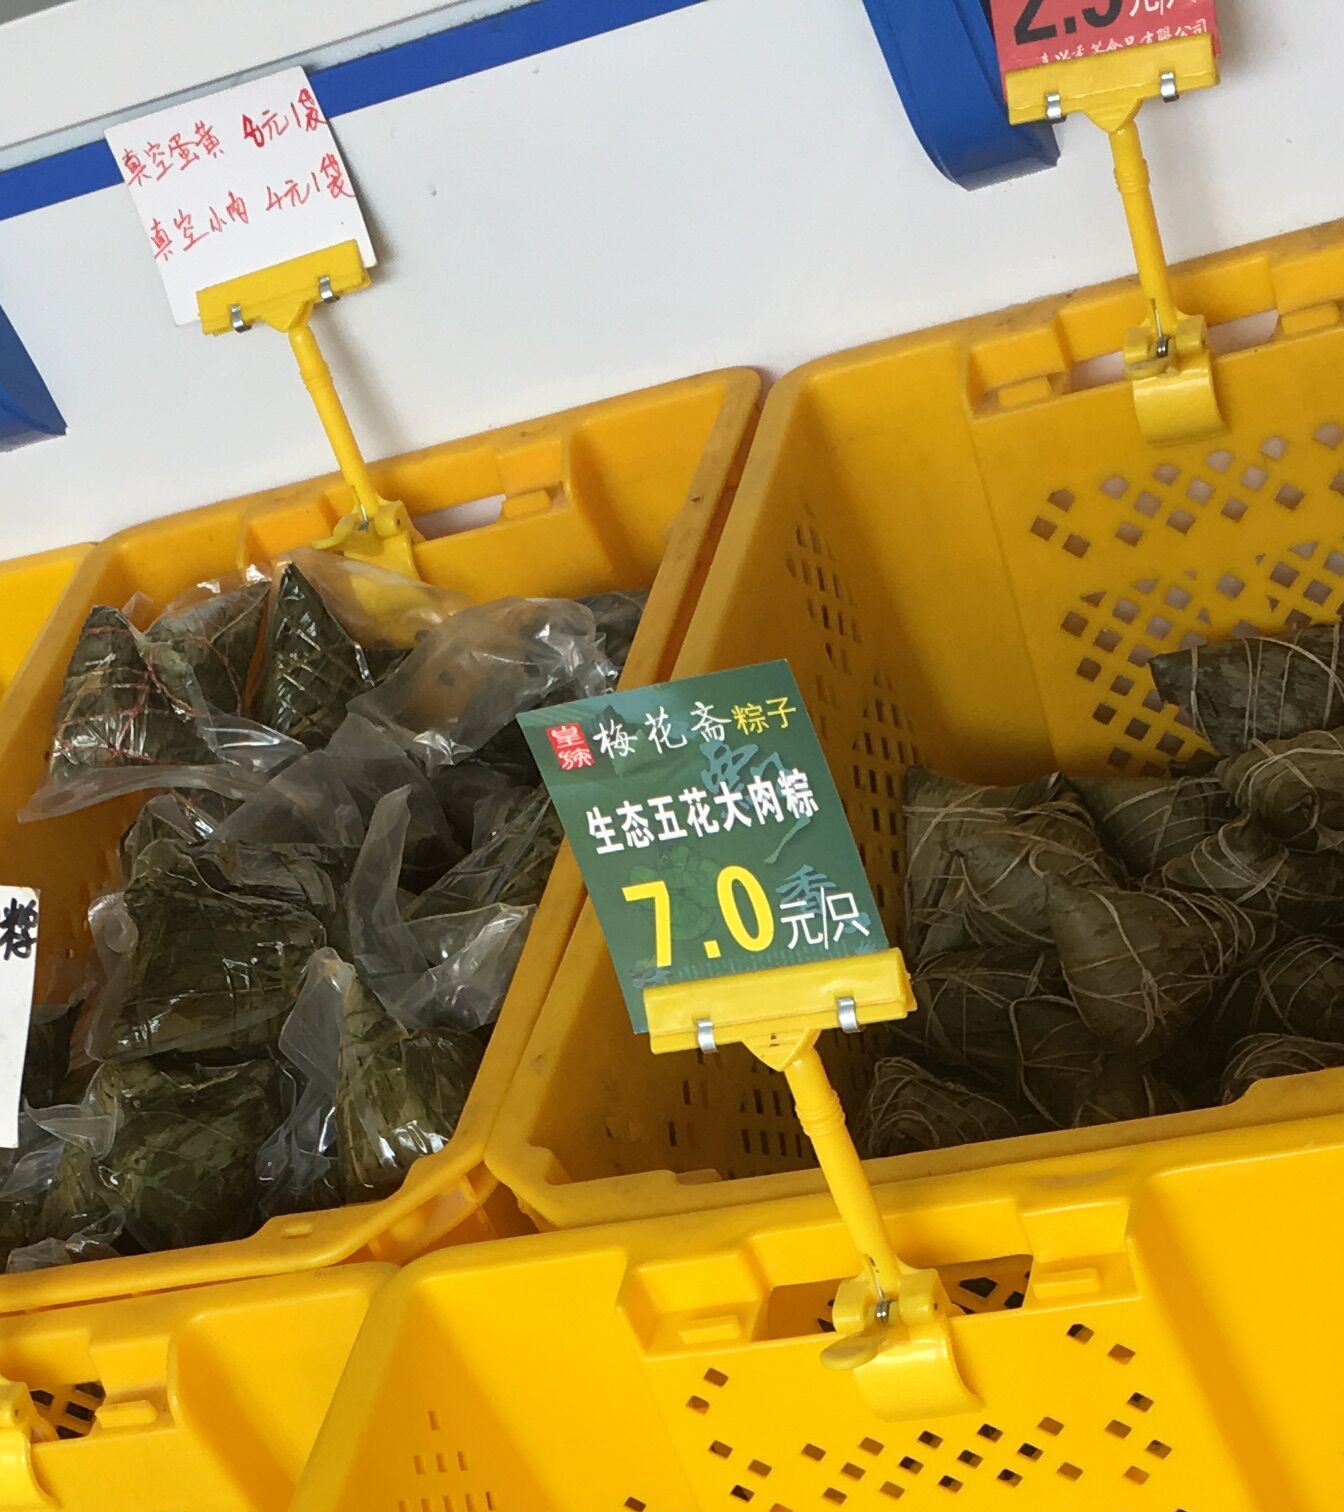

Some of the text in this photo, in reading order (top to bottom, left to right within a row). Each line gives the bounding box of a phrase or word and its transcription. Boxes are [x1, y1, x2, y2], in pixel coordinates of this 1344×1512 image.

[585, 768, 820, 855] 生态五花大肉粽
